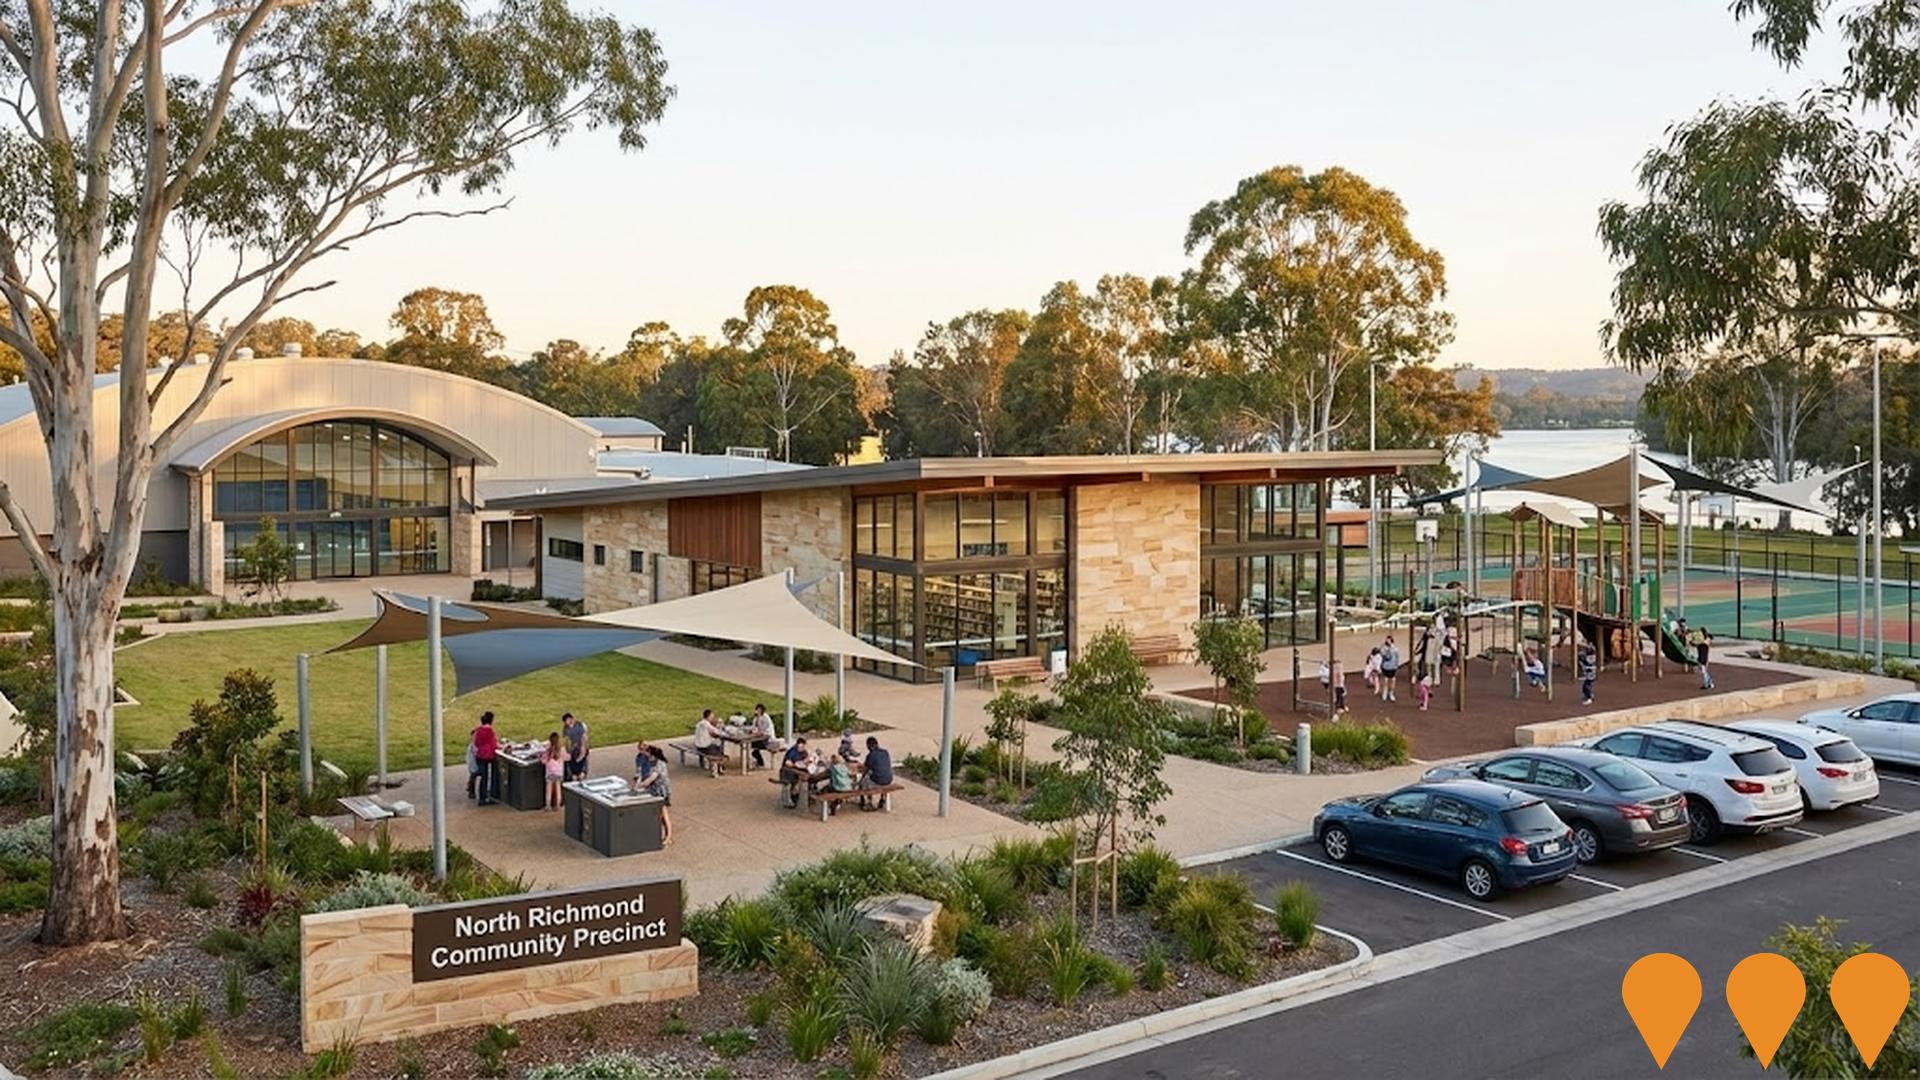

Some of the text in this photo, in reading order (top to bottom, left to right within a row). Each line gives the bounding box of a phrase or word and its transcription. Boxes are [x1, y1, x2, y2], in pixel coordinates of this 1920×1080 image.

[455, 894, 644, 938] North Richmond
[431, 918, 667, 968] Community Precinct
